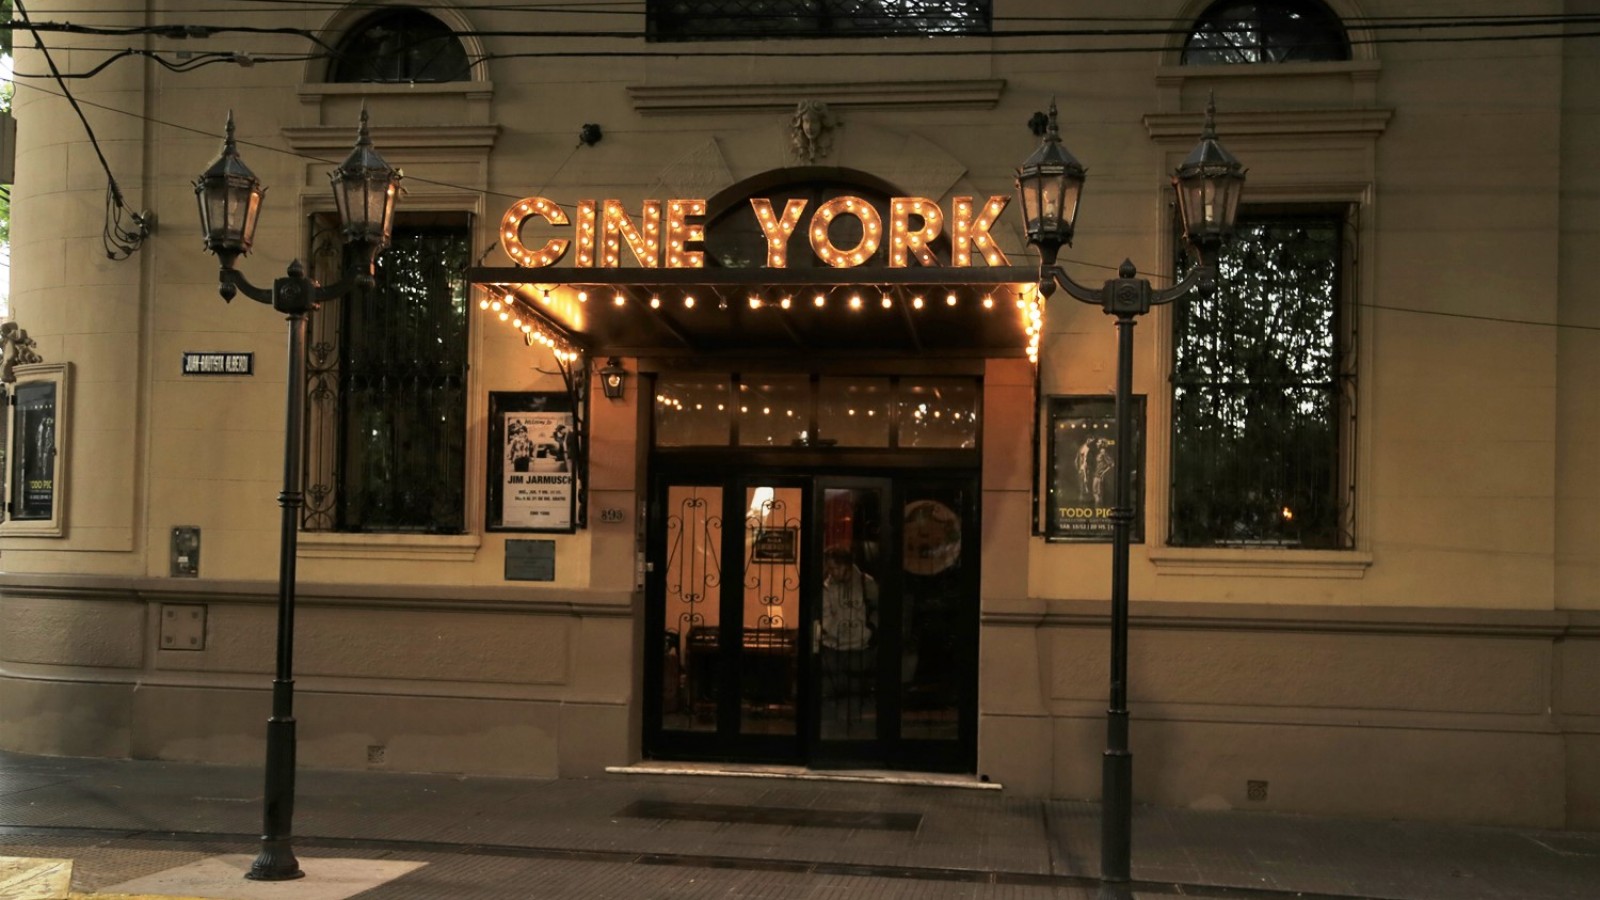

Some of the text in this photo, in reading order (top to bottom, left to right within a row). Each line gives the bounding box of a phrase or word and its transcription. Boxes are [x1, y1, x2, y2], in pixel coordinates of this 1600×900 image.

[499, 194, 1012, 269] CINE YORK
[507, 475, 524, 485] JIM
[1058, 507, 1093, 518] TODO
